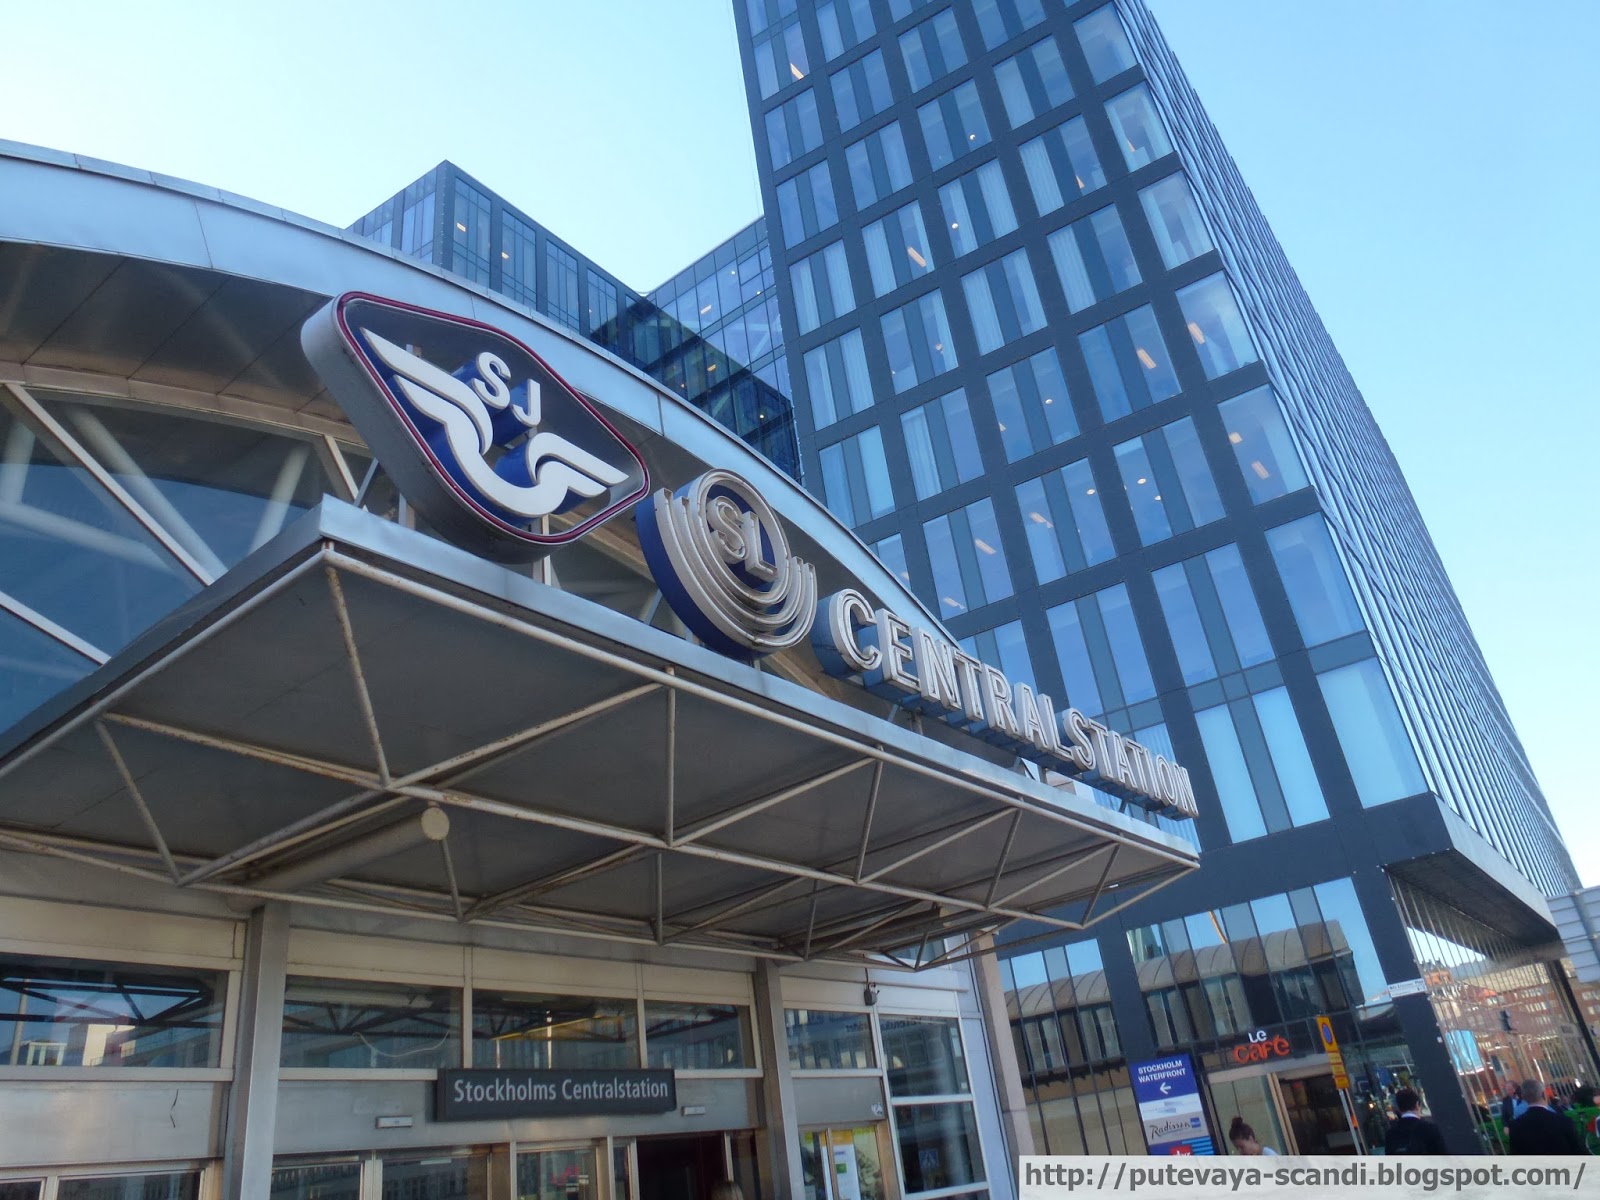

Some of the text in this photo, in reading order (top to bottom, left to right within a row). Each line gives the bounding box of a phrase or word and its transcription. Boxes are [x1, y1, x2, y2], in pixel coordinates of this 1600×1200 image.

[473, 351, 542, 427] SJ
[706, 495, 779, 582] SL
[1138, 1059, 1183, 1075] STOCKHOLM
[1138, 1068, 1186, 1083] WATERFRONT
[454, 1077, 669, 1102] Stockholms Centralstation
